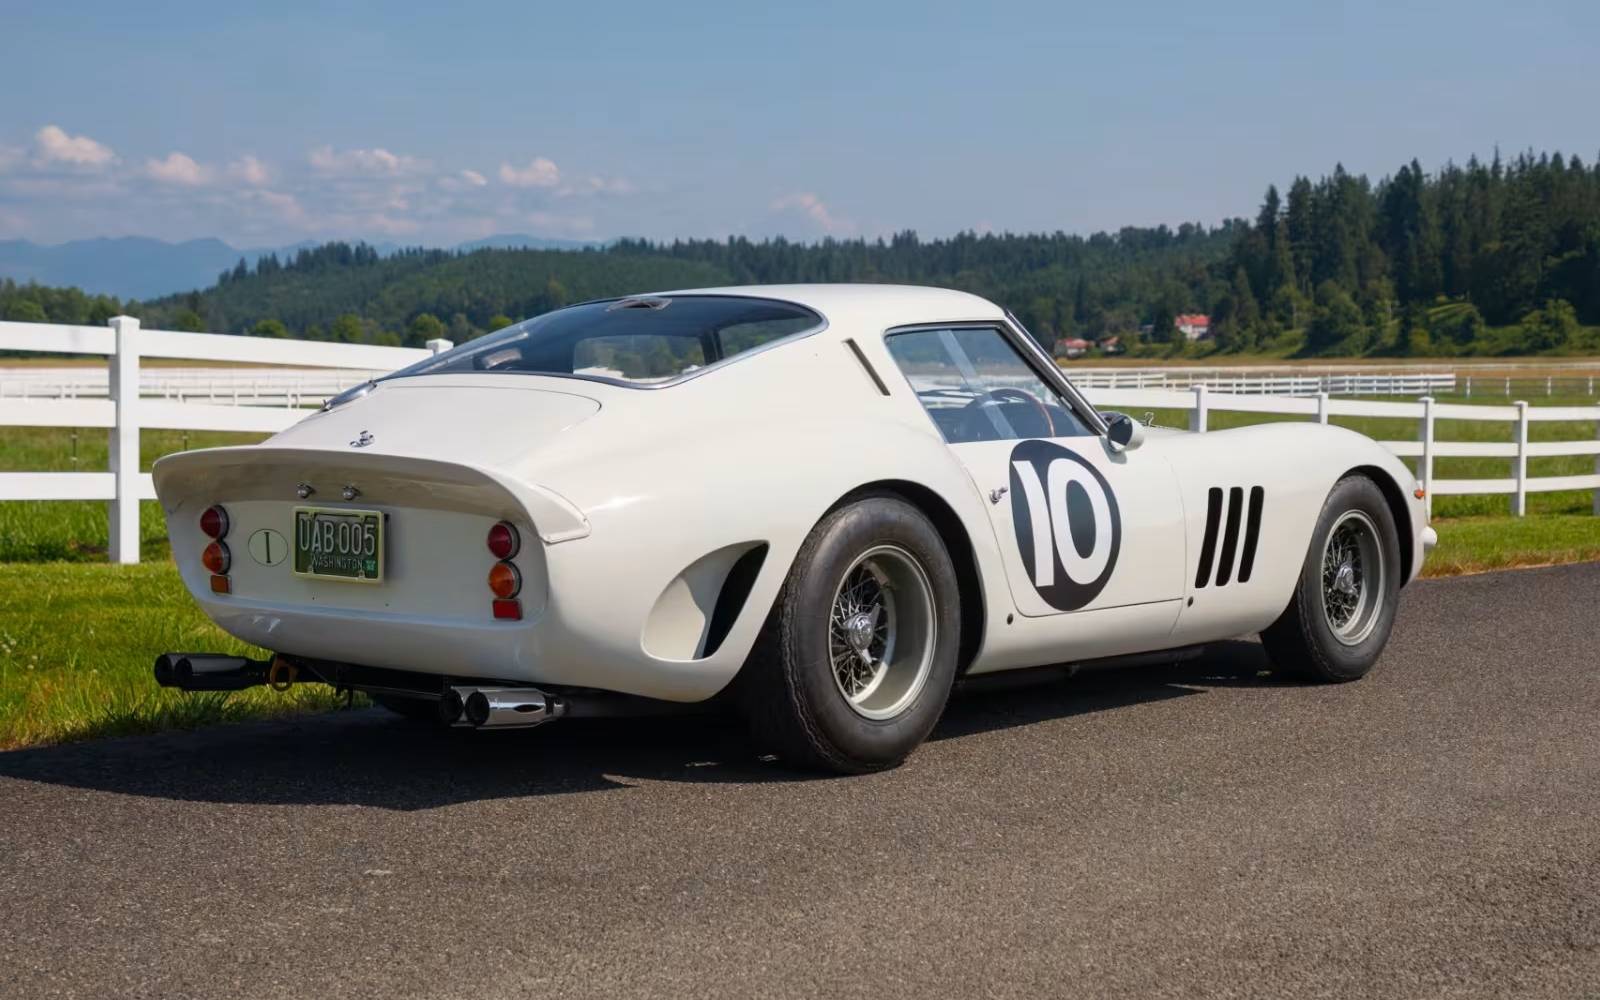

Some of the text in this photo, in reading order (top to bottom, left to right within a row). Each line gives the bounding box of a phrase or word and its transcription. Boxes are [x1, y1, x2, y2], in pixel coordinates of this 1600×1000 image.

[300, 519, 375, 555] UAB 005
[1012, 458, 1112, 587] 10
[312, 555, 363, 569] WASHINGTON
